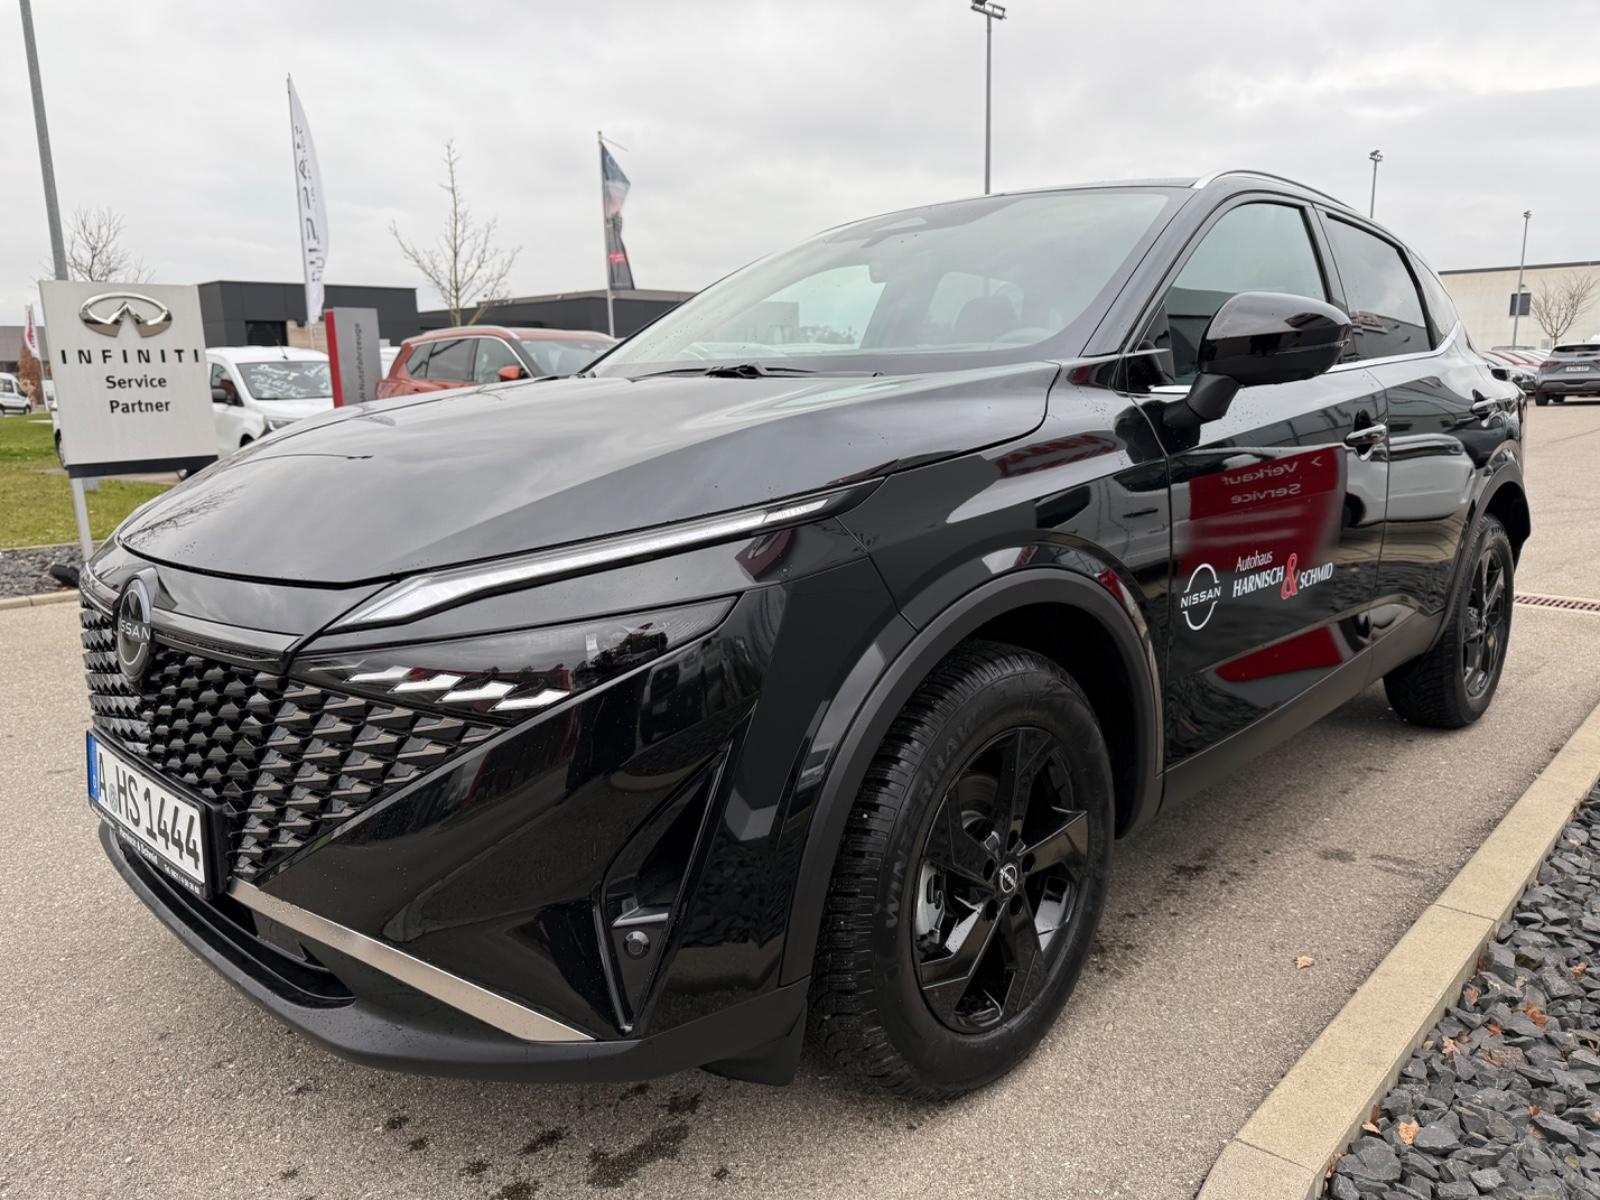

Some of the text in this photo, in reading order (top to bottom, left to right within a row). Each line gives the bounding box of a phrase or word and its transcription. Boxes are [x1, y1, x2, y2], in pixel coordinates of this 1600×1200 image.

[61, 349, 199, 365] INFINITI
[105, 375, 167, 390] Service
[109, 399, 171, 414] Partner
[1236, 550, 1273, 573] Autohaus
[1232, 552, 1334, 600] HARNISCH & SCHMID
[1180, 586, 1222, 609] NISSAN
[120, 619, 151, 641] SSAN
[98, 751, 108, 802] A
